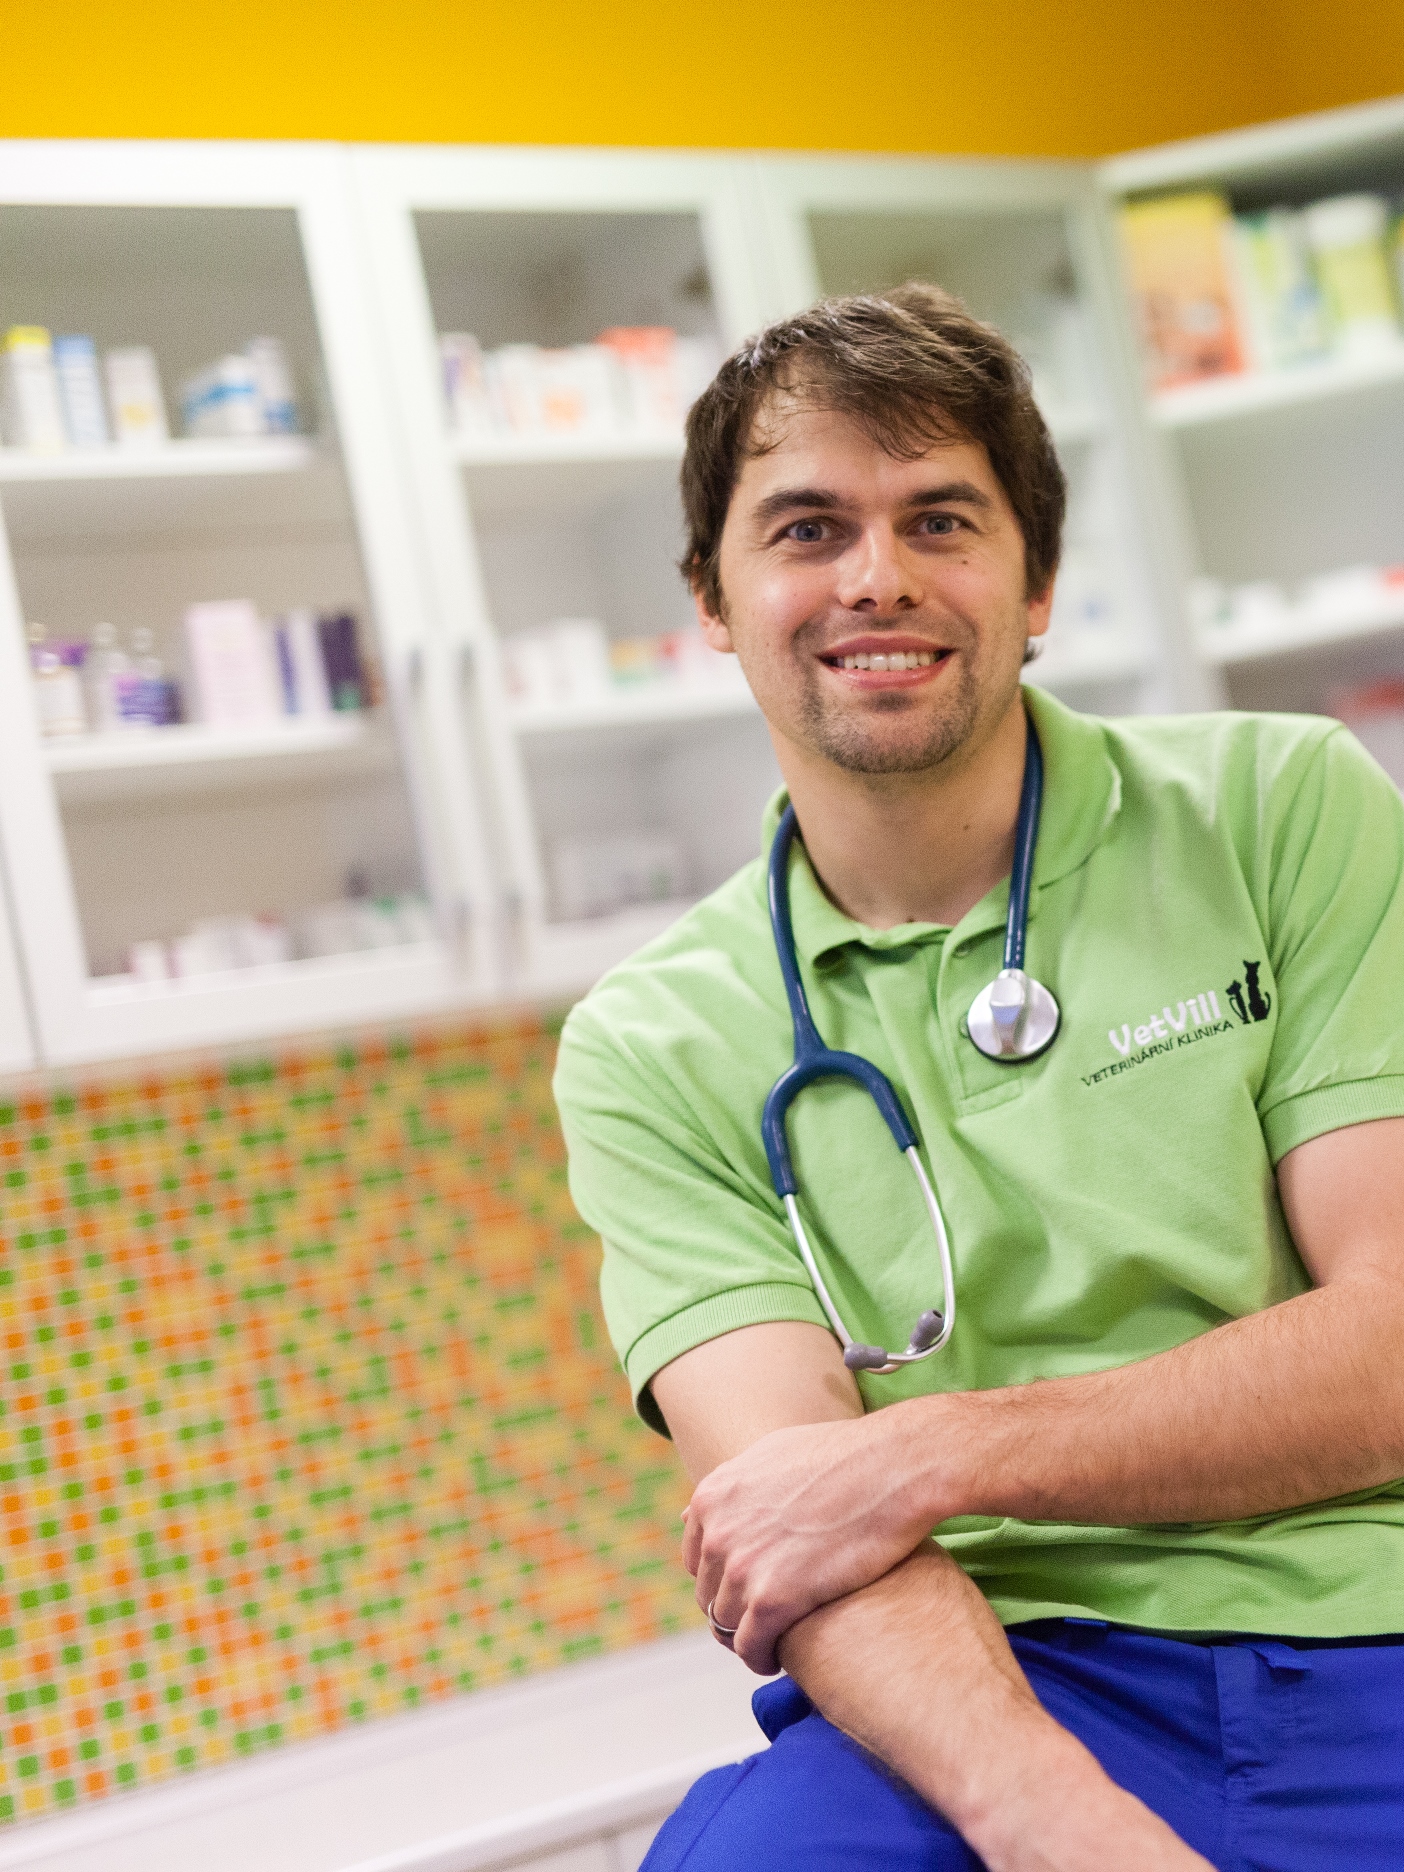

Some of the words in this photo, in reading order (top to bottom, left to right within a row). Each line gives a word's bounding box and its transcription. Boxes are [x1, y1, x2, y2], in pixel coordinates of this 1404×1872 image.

[1081, 1038, 1174, 1087] VETERINÁRNÍ
[1177, 1020, 1234, 1048] KLINIKA
[1108, 990, 1221, 1056] VetVill
